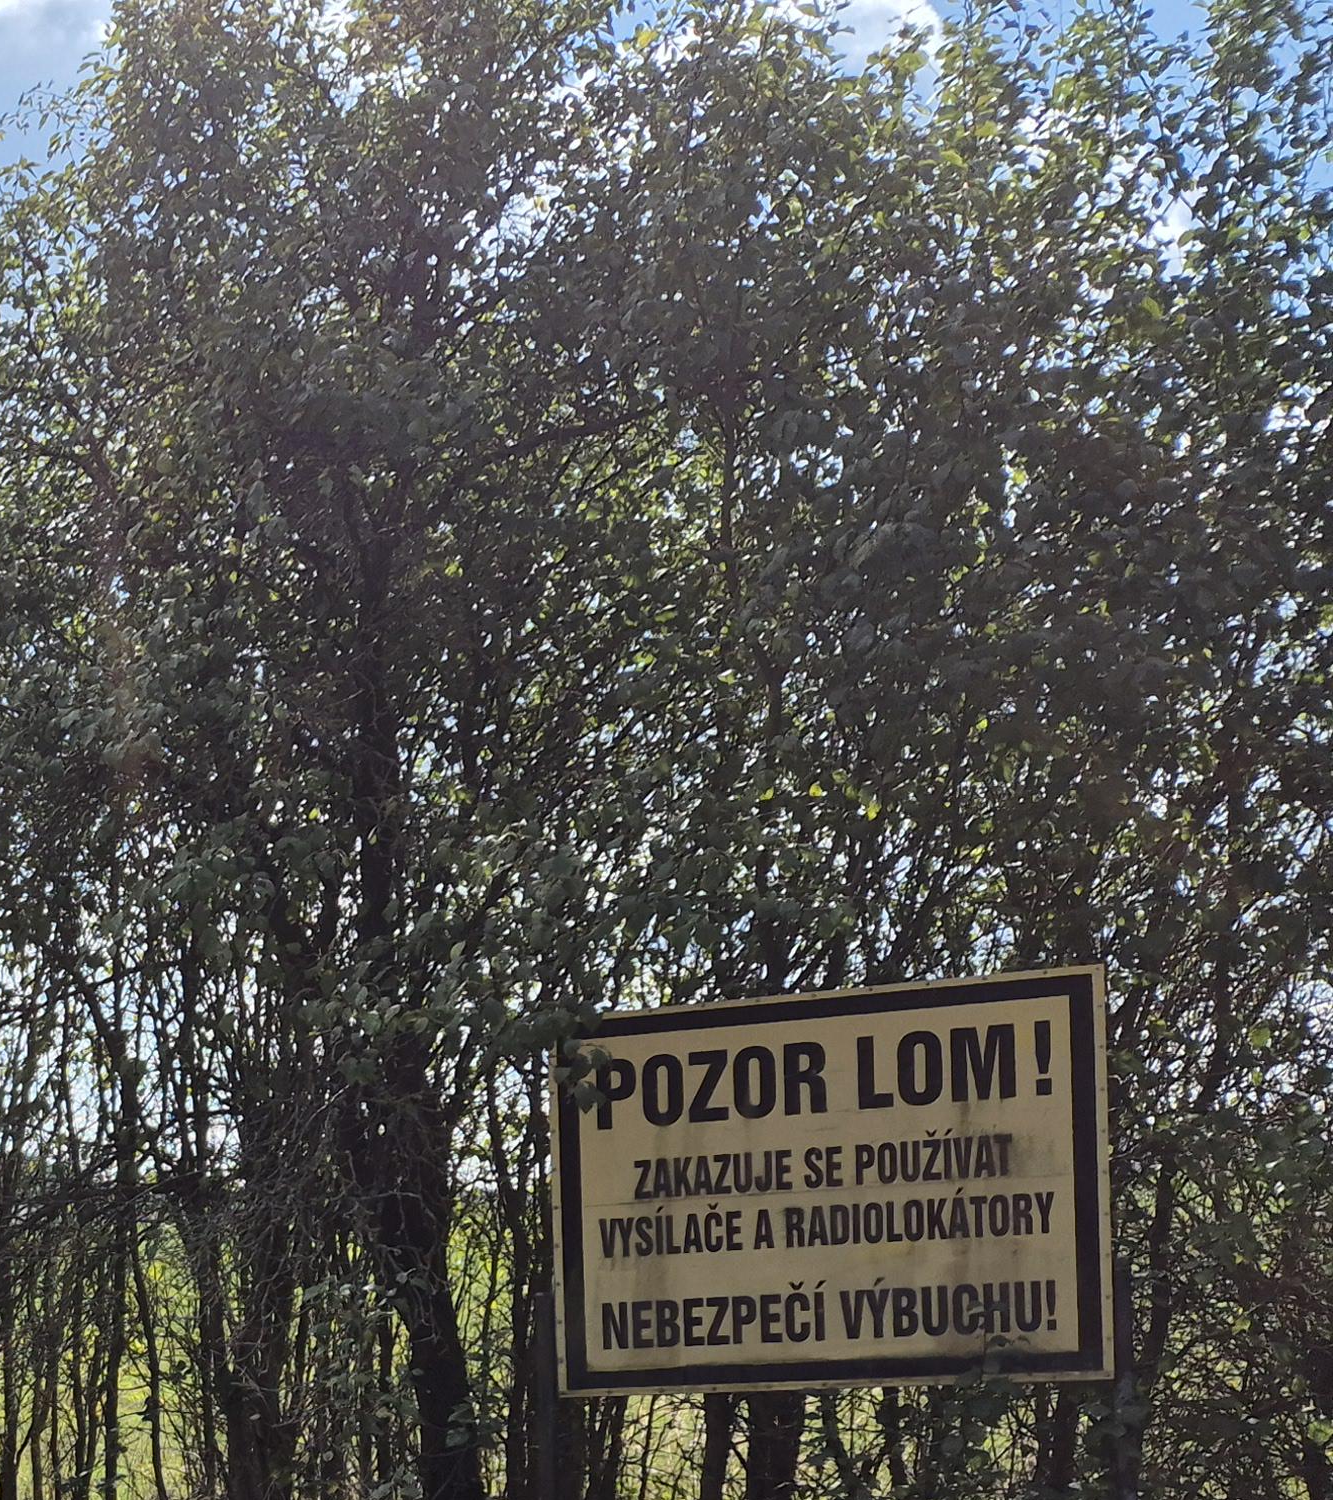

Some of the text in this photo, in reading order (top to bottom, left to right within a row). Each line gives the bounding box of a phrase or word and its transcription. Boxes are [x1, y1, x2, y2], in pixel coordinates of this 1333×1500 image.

[594, 1040, 827, 1130] POZOR
[633, 1129, 1012, 1200] ZAKAZUJE SE POUŽÍVAT
[599, 1185, 1055, 1259] VYSÍLAČE A RADIOLOKÁTORY
[601, 1278, 1057, 1350] NEBEZPEČÍ VÝBUCHU!
